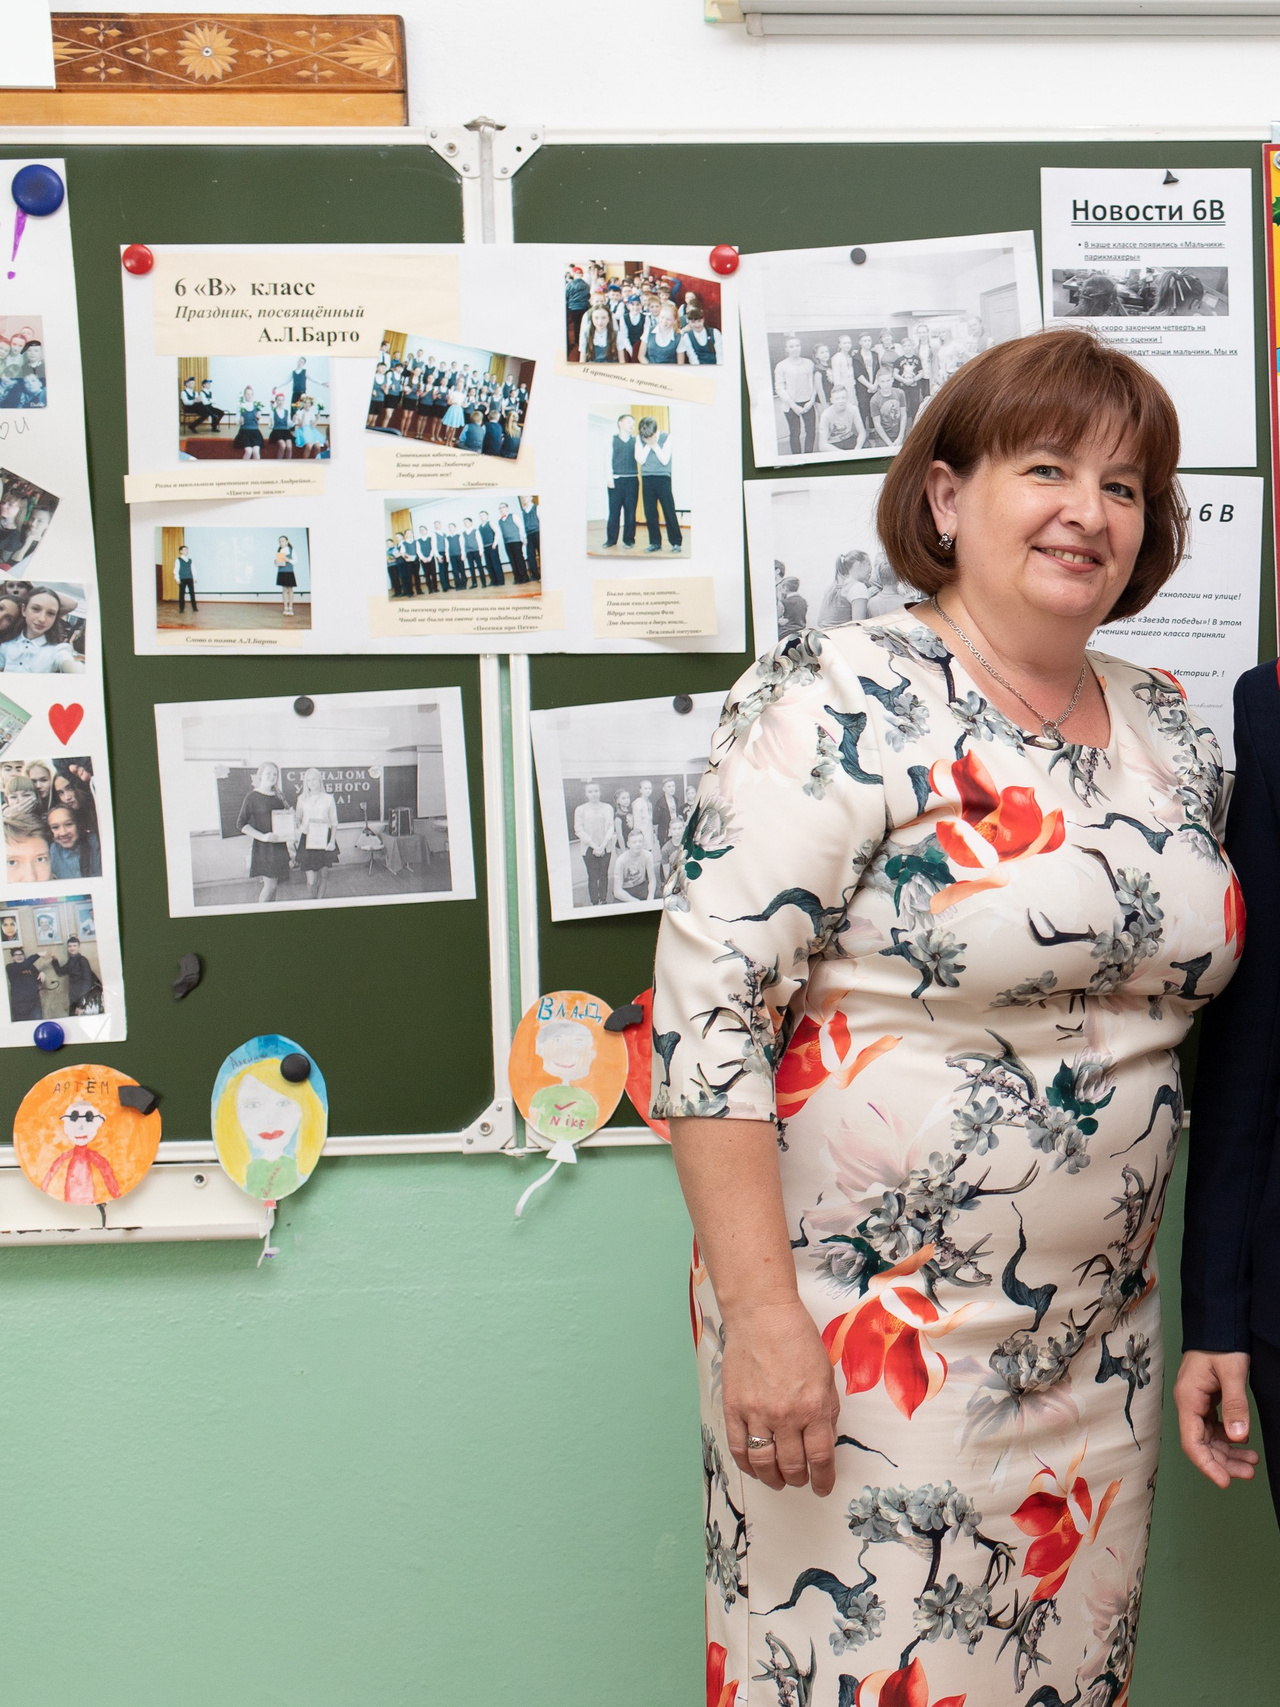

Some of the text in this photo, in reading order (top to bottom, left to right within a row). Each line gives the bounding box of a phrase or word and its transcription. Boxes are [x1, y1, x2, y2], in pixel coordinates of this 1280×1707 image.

[1073, 199, 1224, 220] Новости 6В
[175, 278, 315, 296] 6 «В» класс
[175, 305, 364, 321] Праздник, посвящённый
[258, 327, 359, 346] А.Л.Барто
[1199, 504, 1234, 522] 6 В
[1174, 669, 1210, 677] Истории
